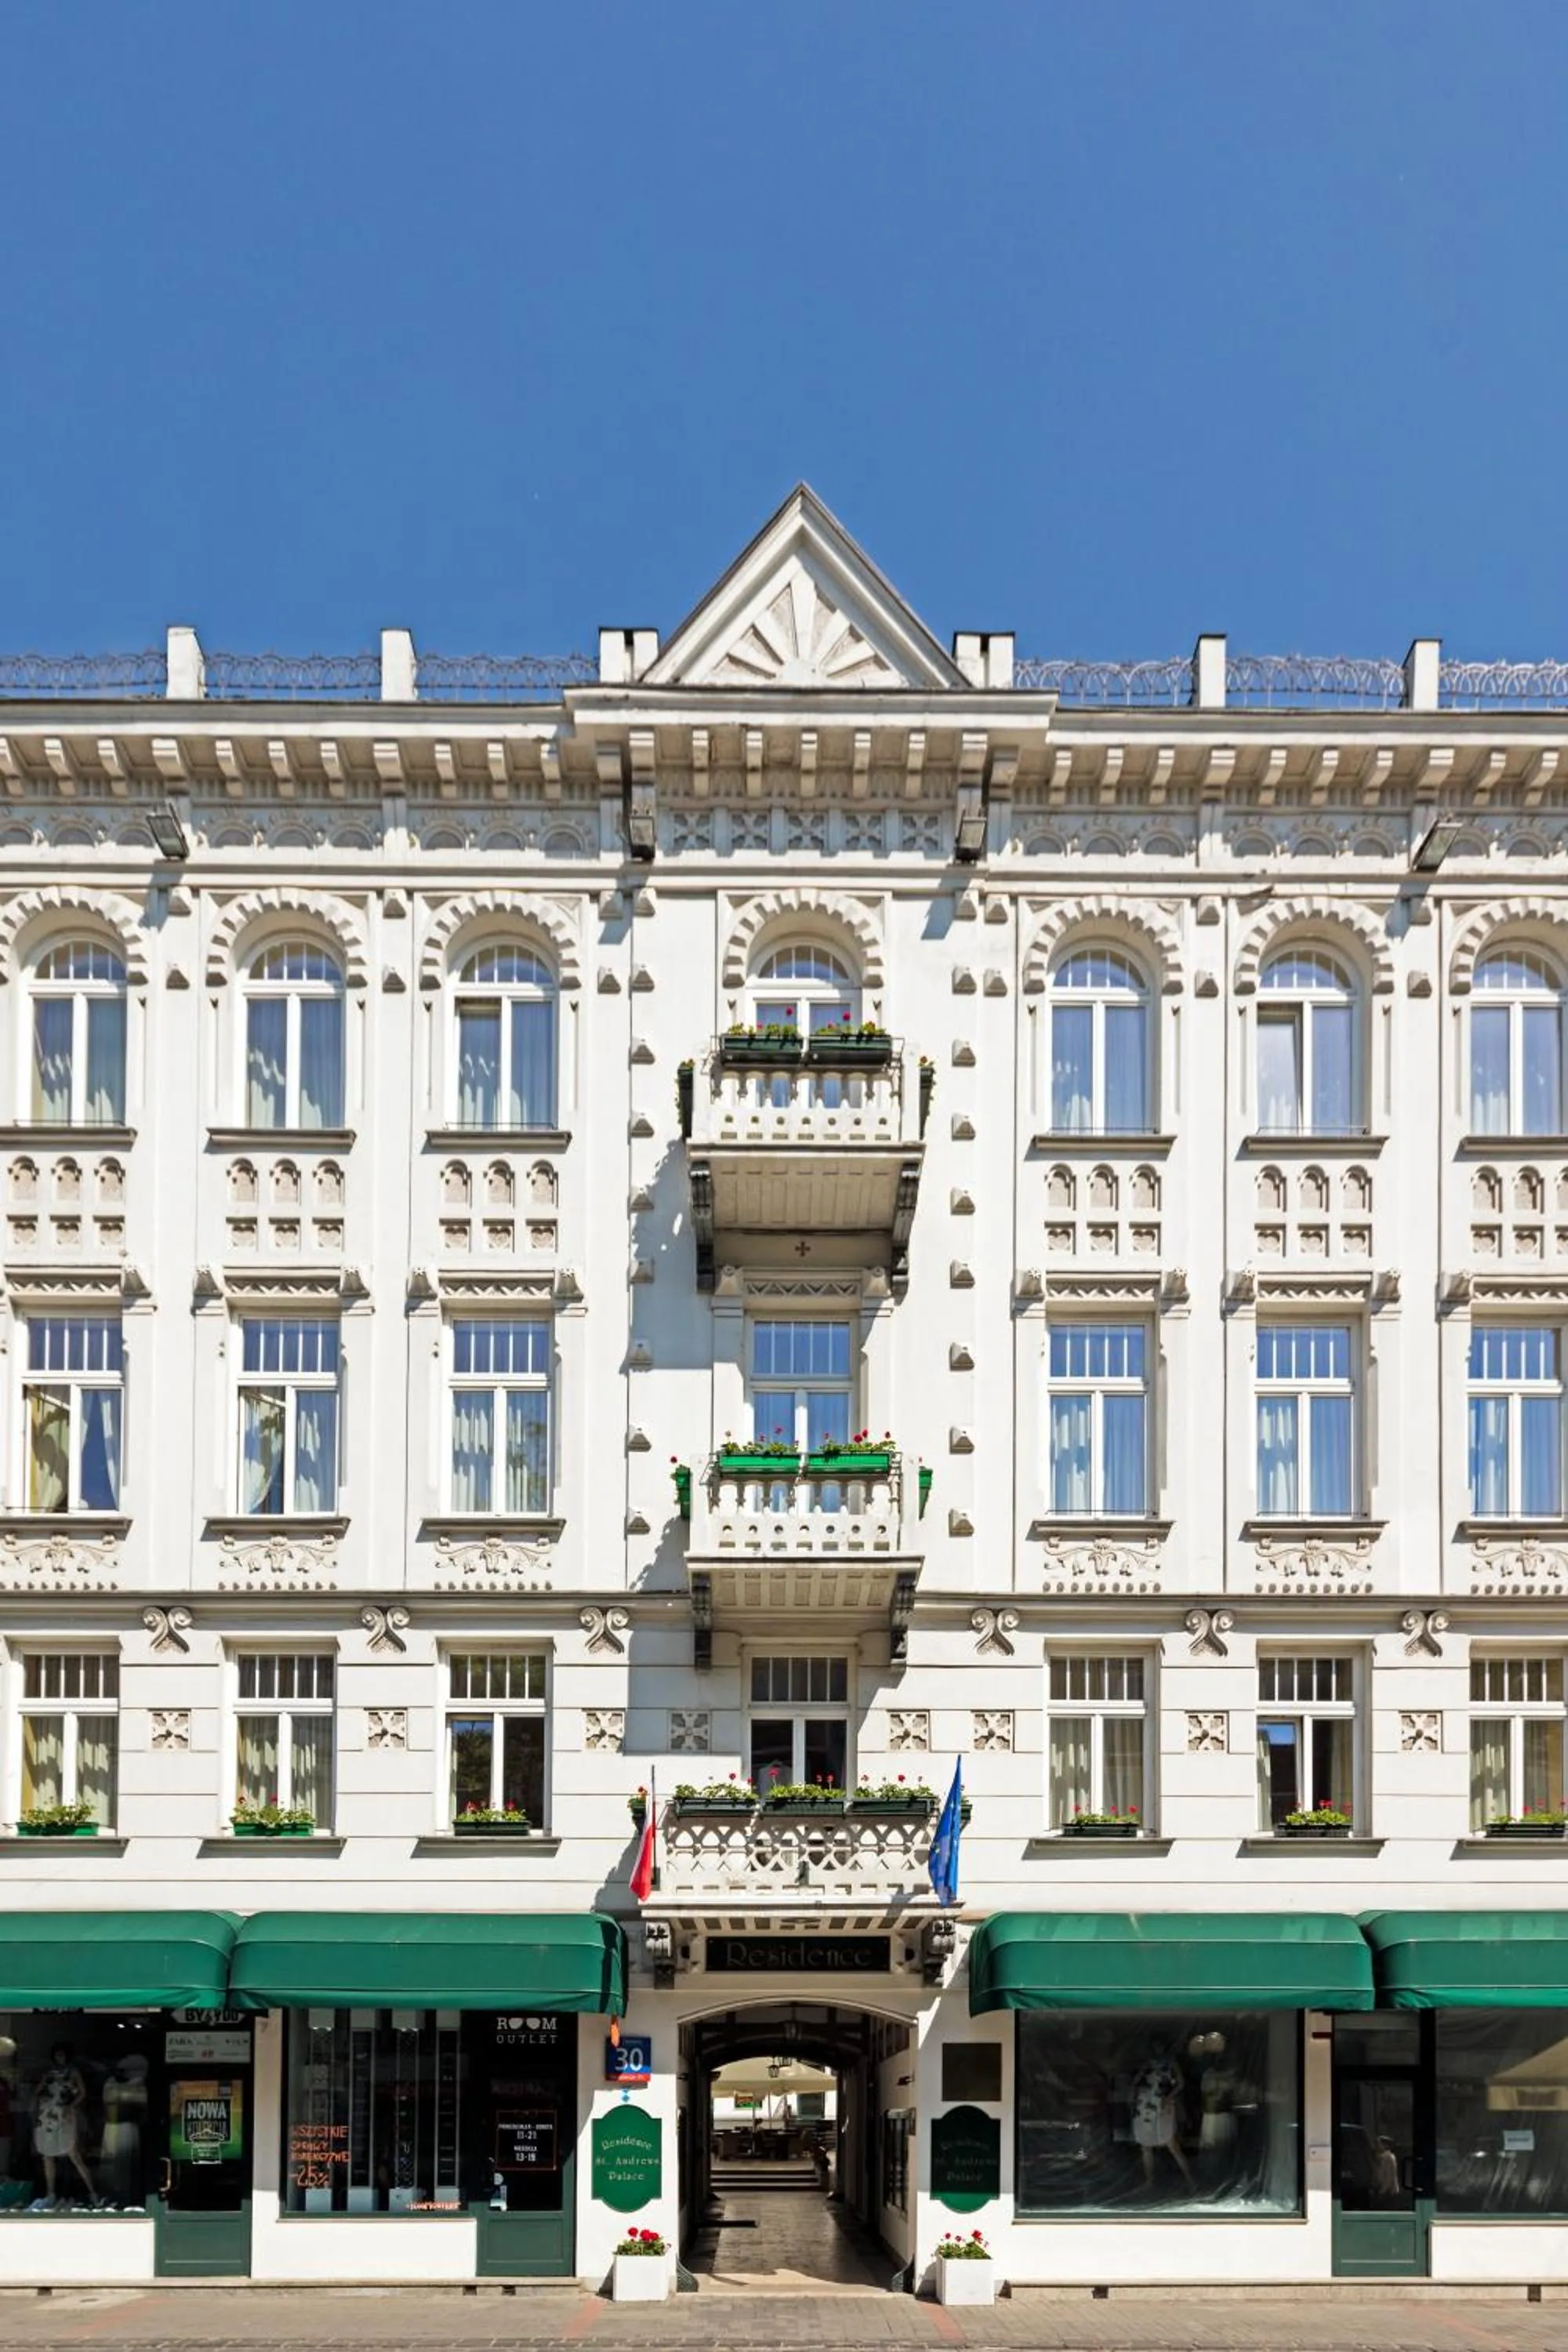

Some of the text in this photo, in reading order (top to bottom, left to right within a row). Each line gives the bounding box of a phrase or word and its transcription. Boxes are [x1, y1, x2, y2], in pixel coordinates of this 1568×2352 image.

[726, 1940, 873, 1966] Residence
[496, 2034, 558, 2044] OUTLET
[615, 2048, 643, 2071] 30
[187, 2101, 227, 2119] NOWA
[601, 2135, 652, 2150] Residence
[608, 2171, 645, 2180] Palace
